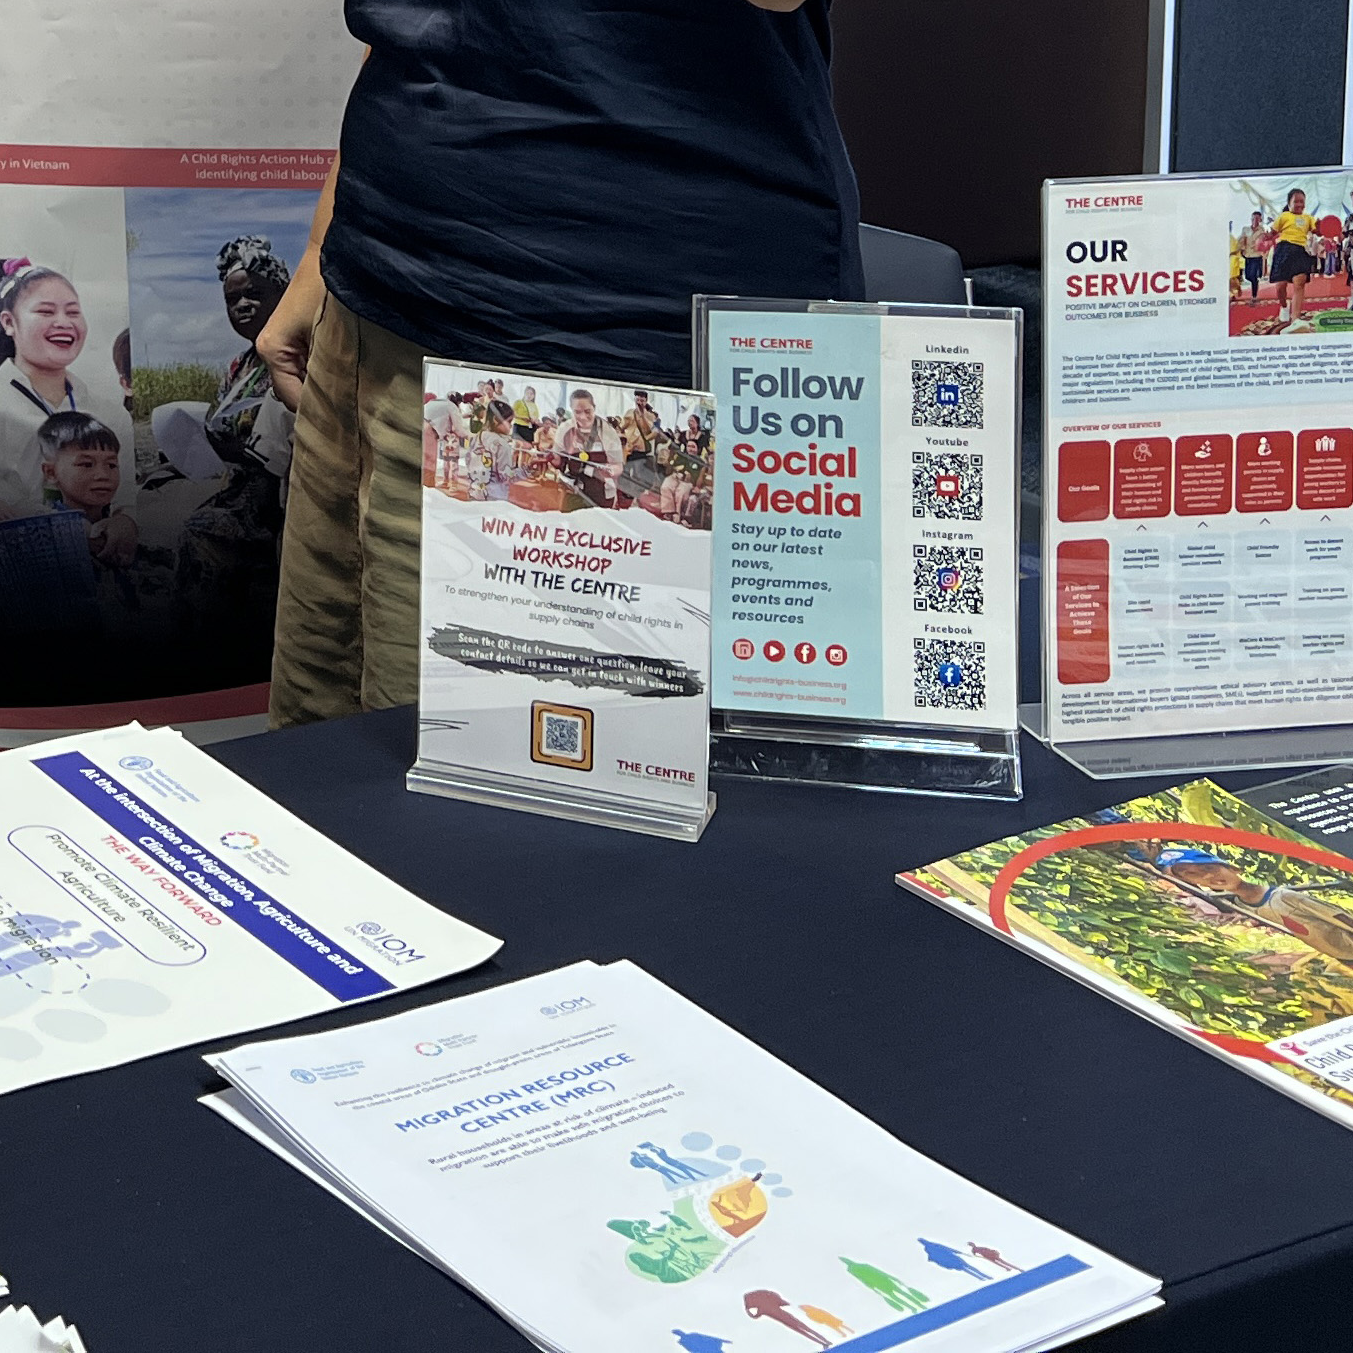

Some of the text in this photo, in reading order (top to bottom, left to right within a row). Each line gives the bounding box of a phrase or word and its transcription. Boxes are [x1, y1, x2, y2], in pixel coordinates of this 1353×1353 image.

[9, 157, 20, 168] in
[21, 158, 70, 170] Vietnam
[179, 153, 189, 164] A
[220, 153, 257, 166] Rights
[259, 153, 297, 164] Action
[300, 154, 324, 165] Hub
[195, 168, 258, 182] identifying
[260, 169, 288, 180] child
[1065, 195, 1145, 209] THE CENTRE
[1065, 239, 1128, 264] OUR
[1065, 268, 1205, 298] SERVICES
[729, 336, 812, 350] THE CENTRE
[925, 344, 970, 355] Linkedin
[732, 367, 864, 402] Follow
[733, 405, 843, 439] Us on
[925, 437, 969, 448] Youtube
[732, 443, 857, 478] Social
[732, 481, 862, 518] Media
[482, 517, 652, 556] WIN AN EXCLUSIVE
[731, 522, 842, 539] Stay up to date
[922, 530, 974, 541] Instagram
[512, 544, 613, 575] WORKSHOP
[731, 542, 823, 556] on our latest
[731, 557, 774, 572] news,
[485, 563, 640, 603] WITH THE CENTRE
[731, 574, 833, 593] programmes,
[445, 584, 683, 630] To strengthen your understanding of child rights in
[731, 594, 814, 607] events and
[528, 612, 595, 630] supply chains
[731, 610, 804, 625] resources
[924, 624, 973, 636] Facebook
[616, 759, 695, 782] THE CENTRE
[79, 769, 100, 780] At
[94, 778, 118, 795] the
[112, 792, 183, 845] intersection
[178, 844, 202, 855] of
[191, 854, 255, 902] Migration,
[252, 900, 331, 954] Agriculture
[326, 953, 364, 975] and
[101, 834, 222, 926] THE WAY FORWARD
[138, 836, 234, 907] Climate Change
[394, 1052, 634, 1132] MIGRATION RESOURCE
[460, 1079, 616, 1133] CENTRE (MRC)
